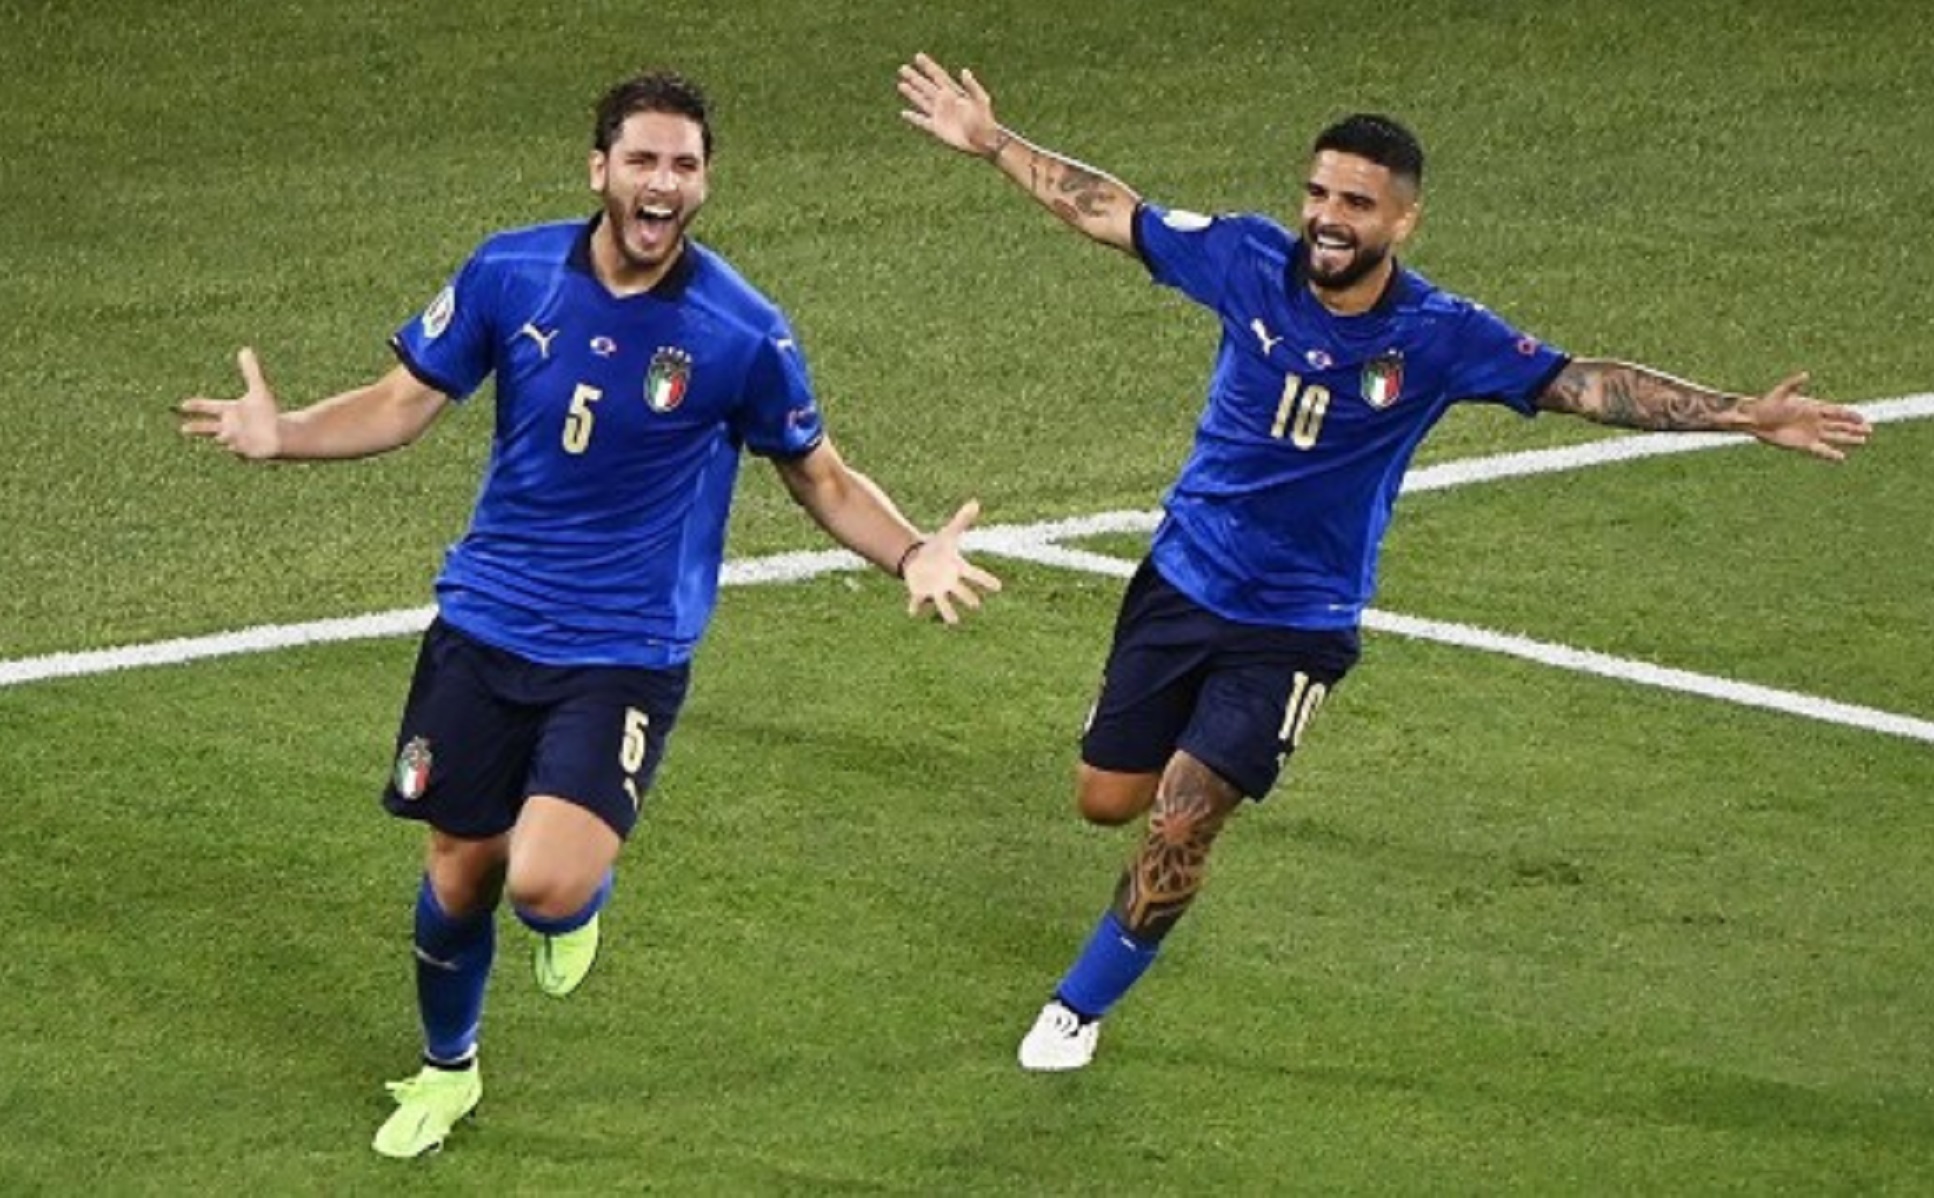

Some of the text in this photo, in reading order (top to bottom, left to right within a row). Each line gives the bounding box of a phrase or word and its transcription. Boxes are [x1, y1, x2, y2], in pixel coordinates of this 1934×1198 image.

[562, 383, 602, 454] 5
[1271, 373, 1330, 450] 10
[619, 706, 650, 773] 5
